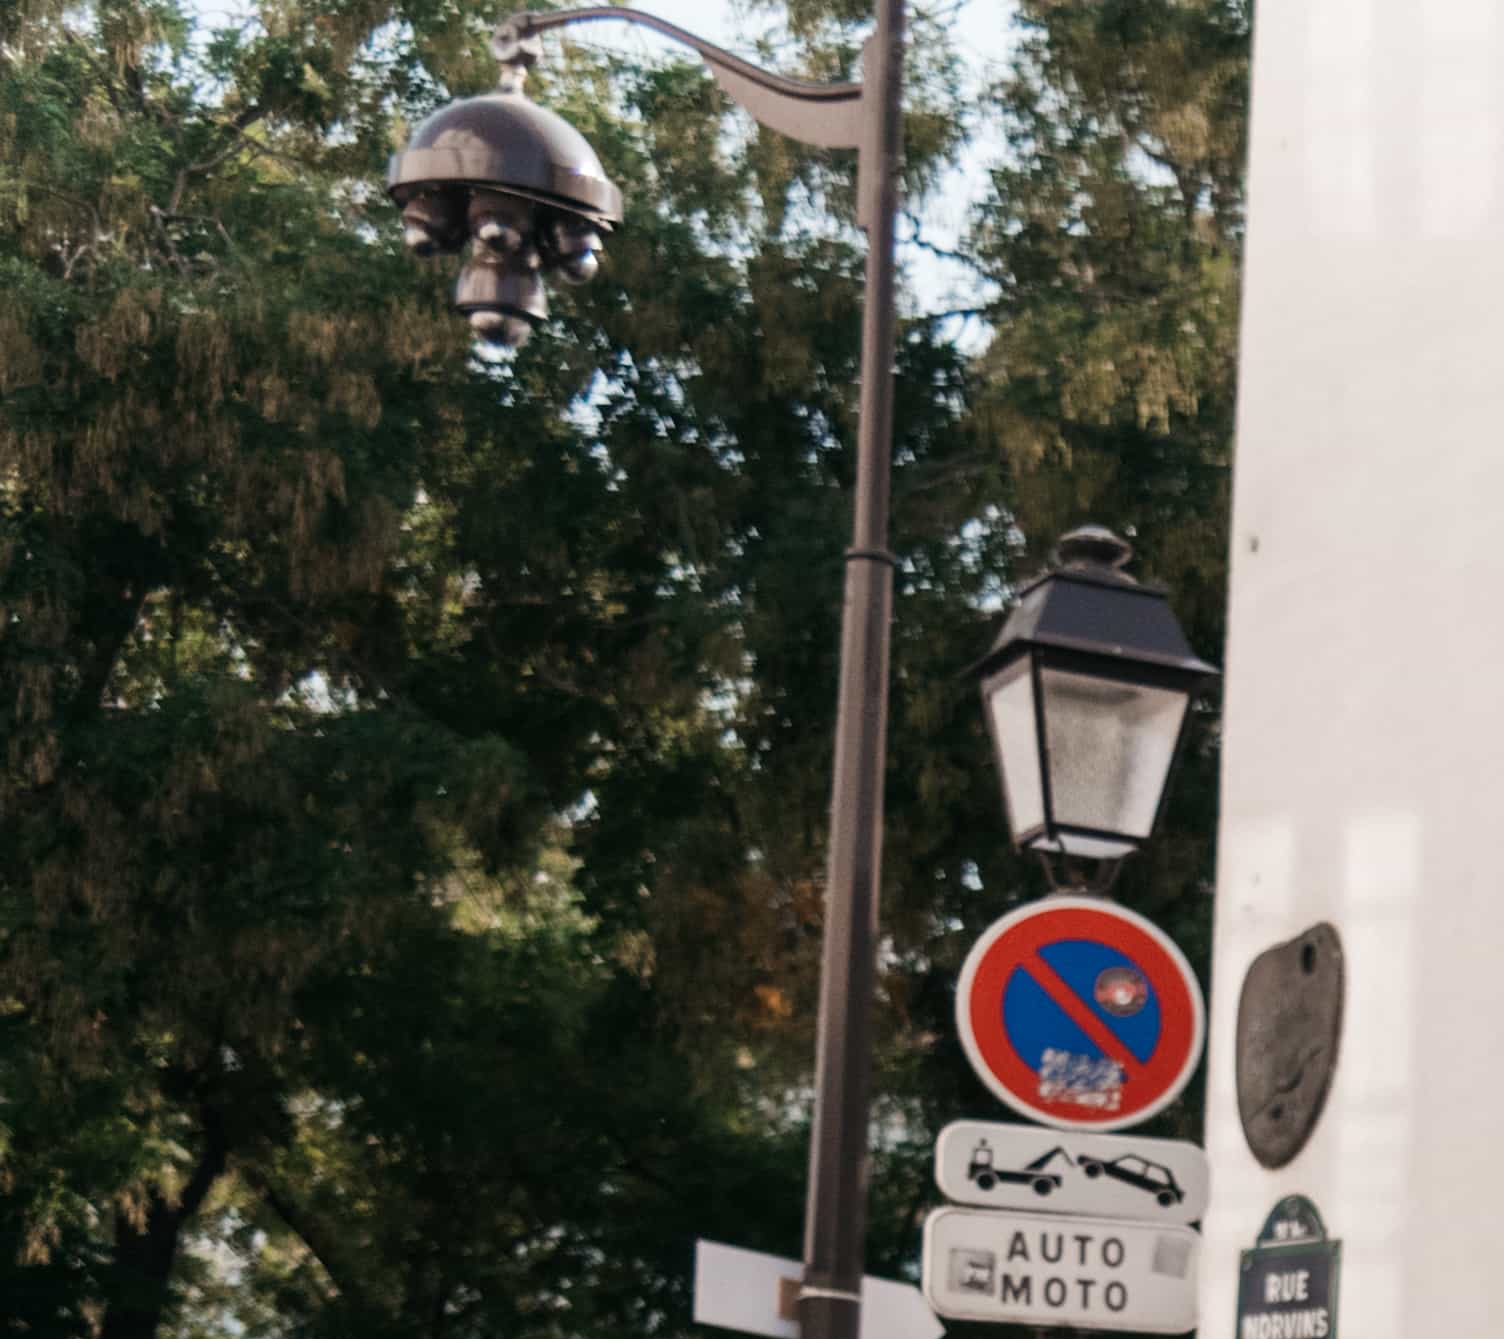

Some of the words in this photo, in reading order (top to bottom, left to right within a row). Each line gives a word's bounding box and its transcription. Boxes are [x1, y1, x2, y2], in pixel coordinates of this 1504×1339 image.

[1006, 1229, 1126, 1269] AUTO
[1000, 1272, 1129, 1312] MOTO
[1264, 1269, 1310, 1304] RUE
